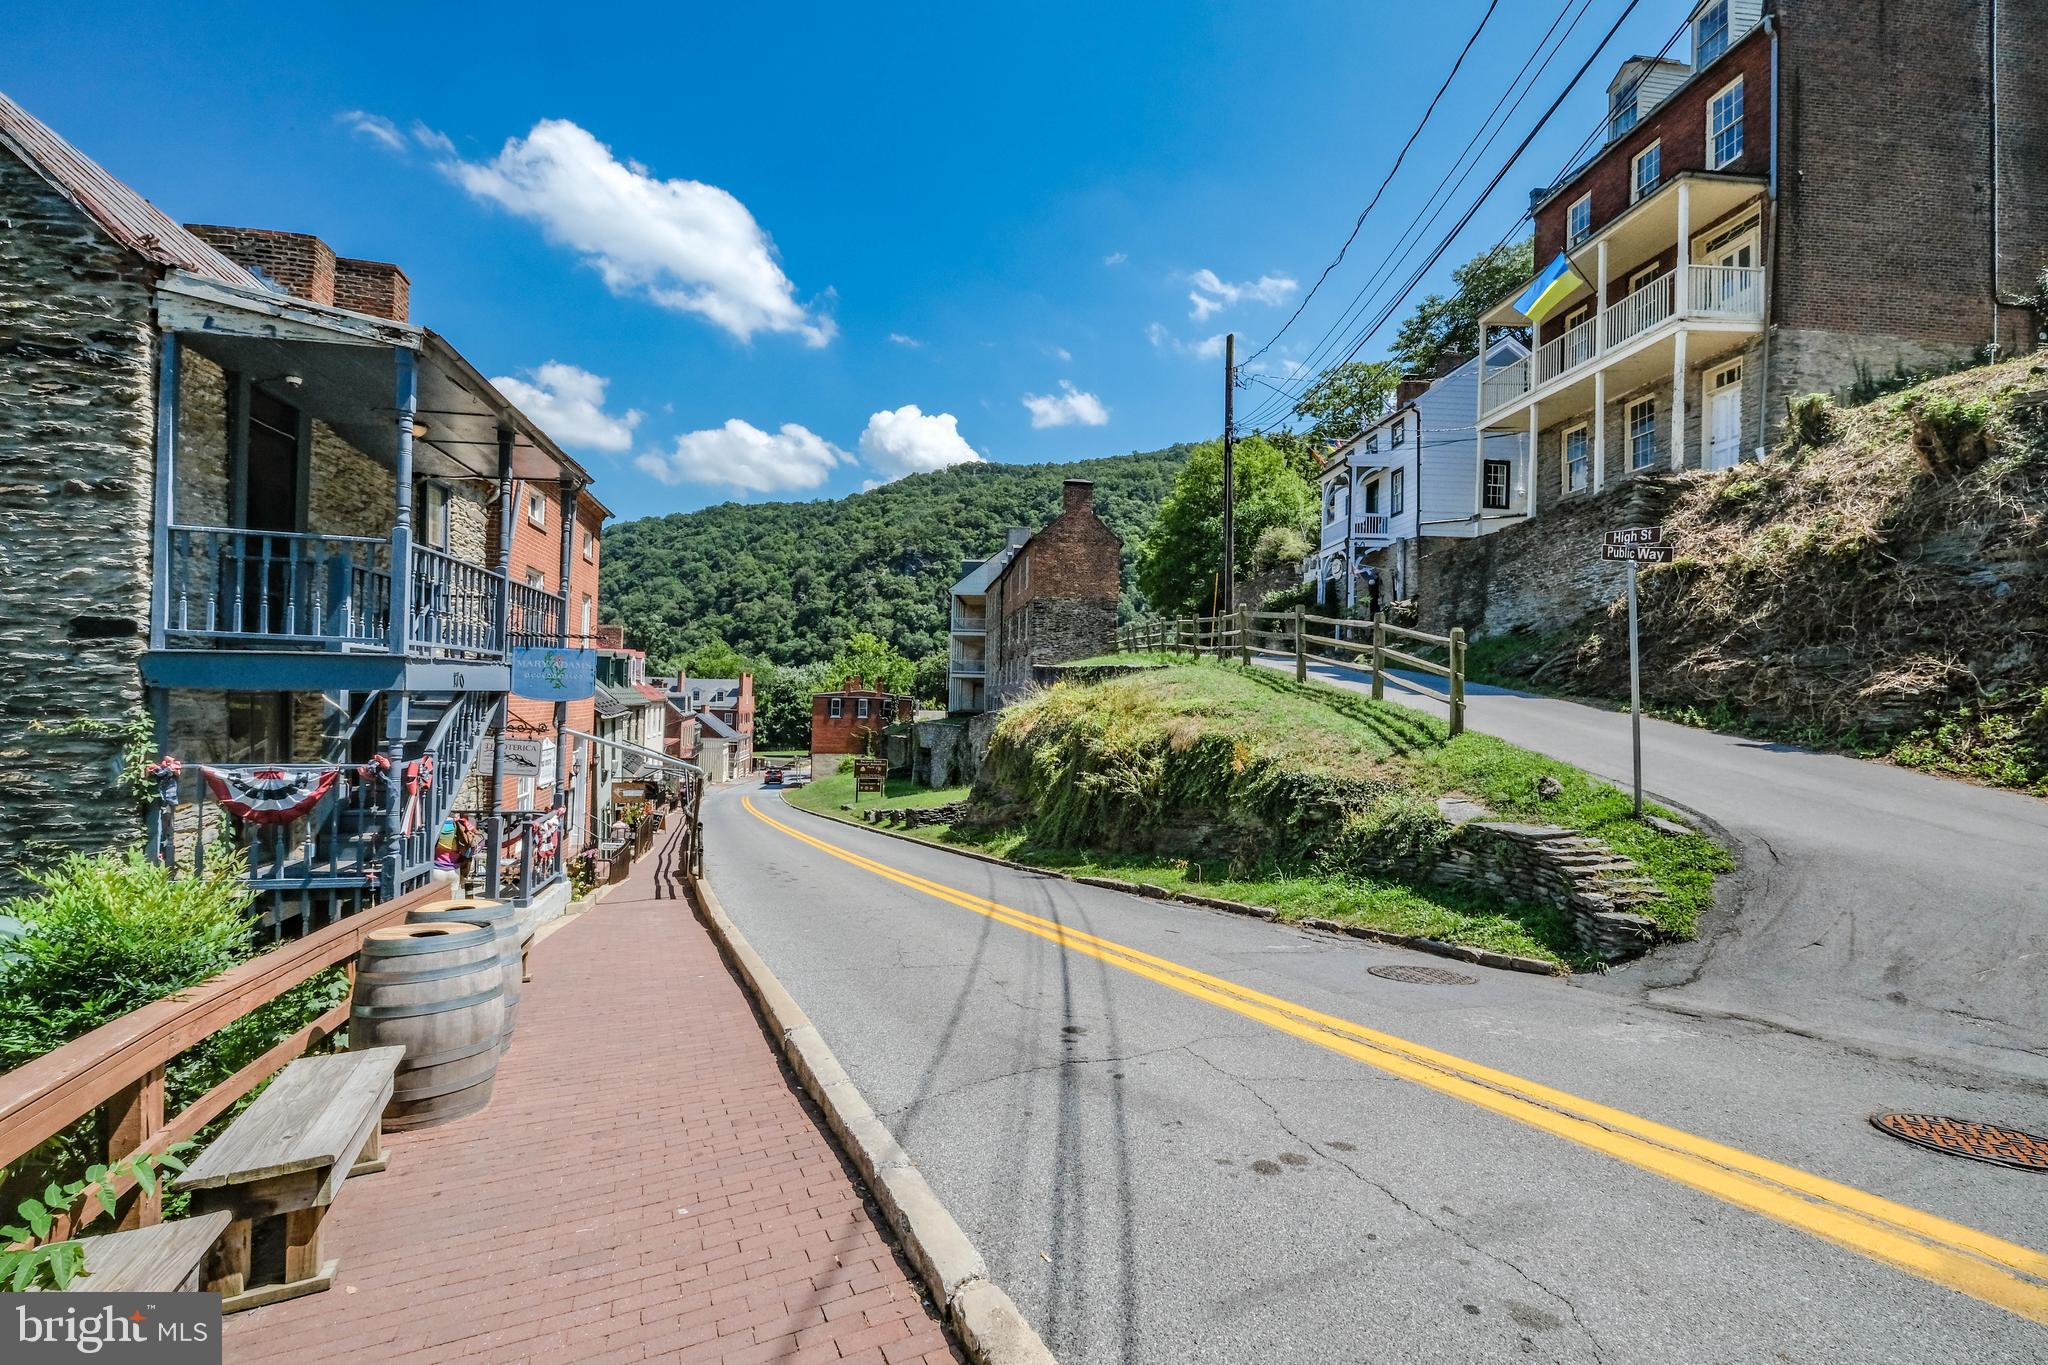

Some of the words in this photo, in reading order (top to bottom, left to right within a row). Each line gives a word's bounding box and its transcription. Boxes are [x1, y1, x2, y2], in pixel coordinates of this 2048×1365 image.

[1613, 531, 1637, 544] High
[1640, 529, 1652, 541] St
[1607, 546, 1636, 559] Public
[1637, 548, 1665, 562] Way
